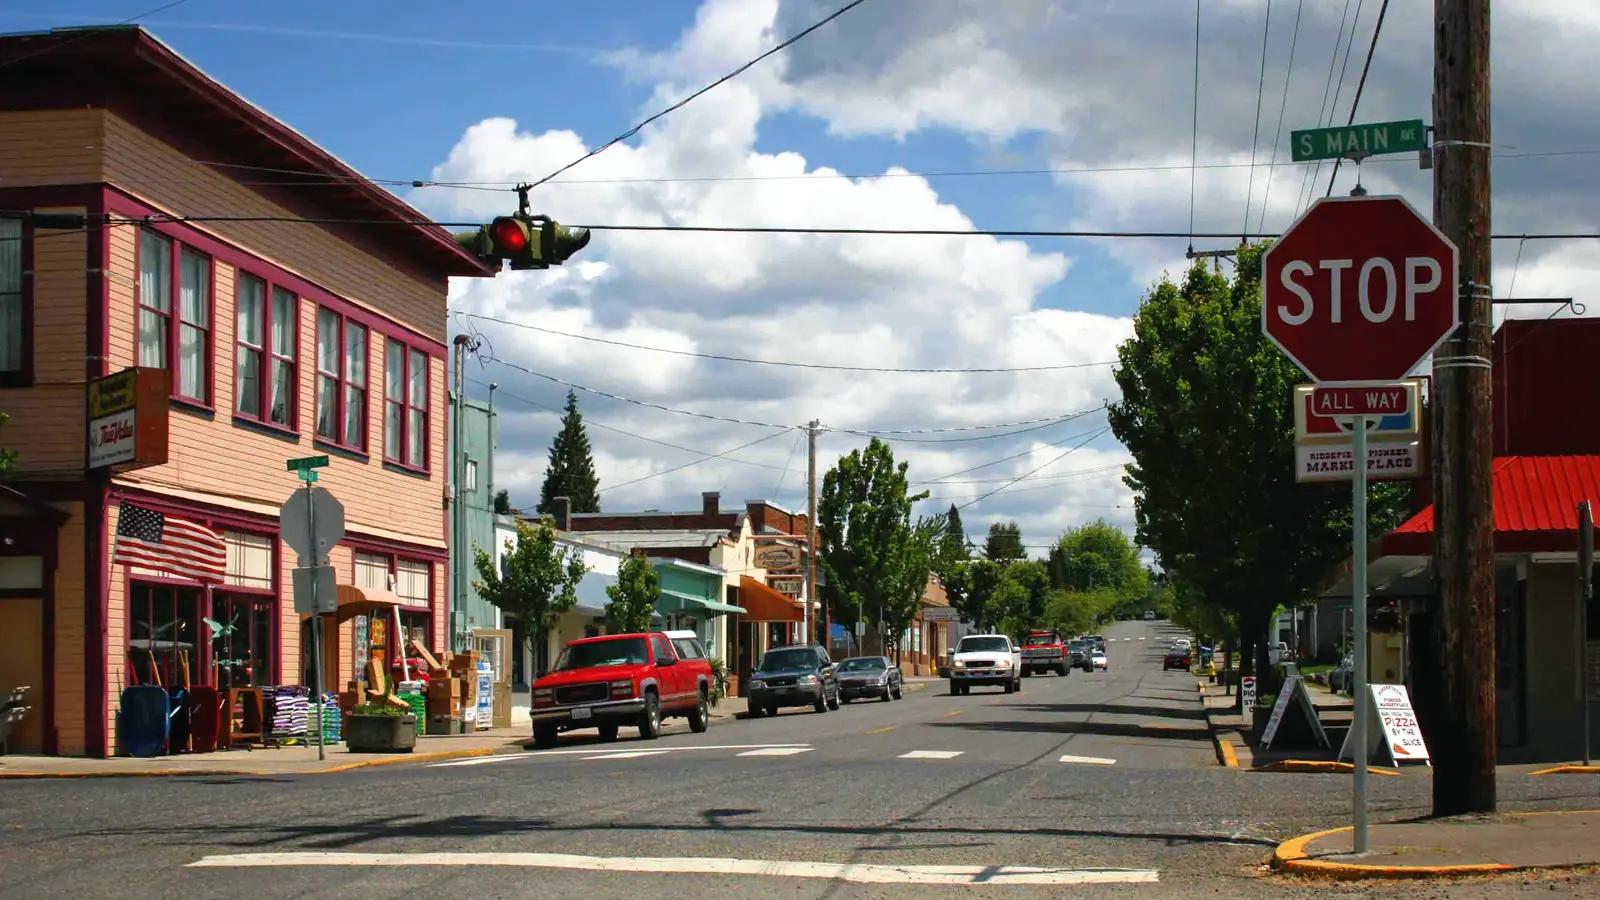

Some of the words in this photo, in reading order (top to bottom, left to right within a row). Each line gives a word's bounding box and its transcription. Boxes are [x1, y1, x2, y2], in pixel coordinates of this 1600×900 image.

[1300, 134, 1314, 157] S
[1326, 126, 1388, 154] MAIN
[1400, 127, 1416, 141] AVE
[1277, 256, 1442, 326] STOP
[1321, 392, 1354, 410] ALL
[1365, 391, 1400, 409] WAY
[1384, 717, 1417, 728] PIZZA
[1392, 728, 1400, 736] BY
[1402, 728, 1416, 736] THE
[1402, 738, 1422, 746] SLICE
